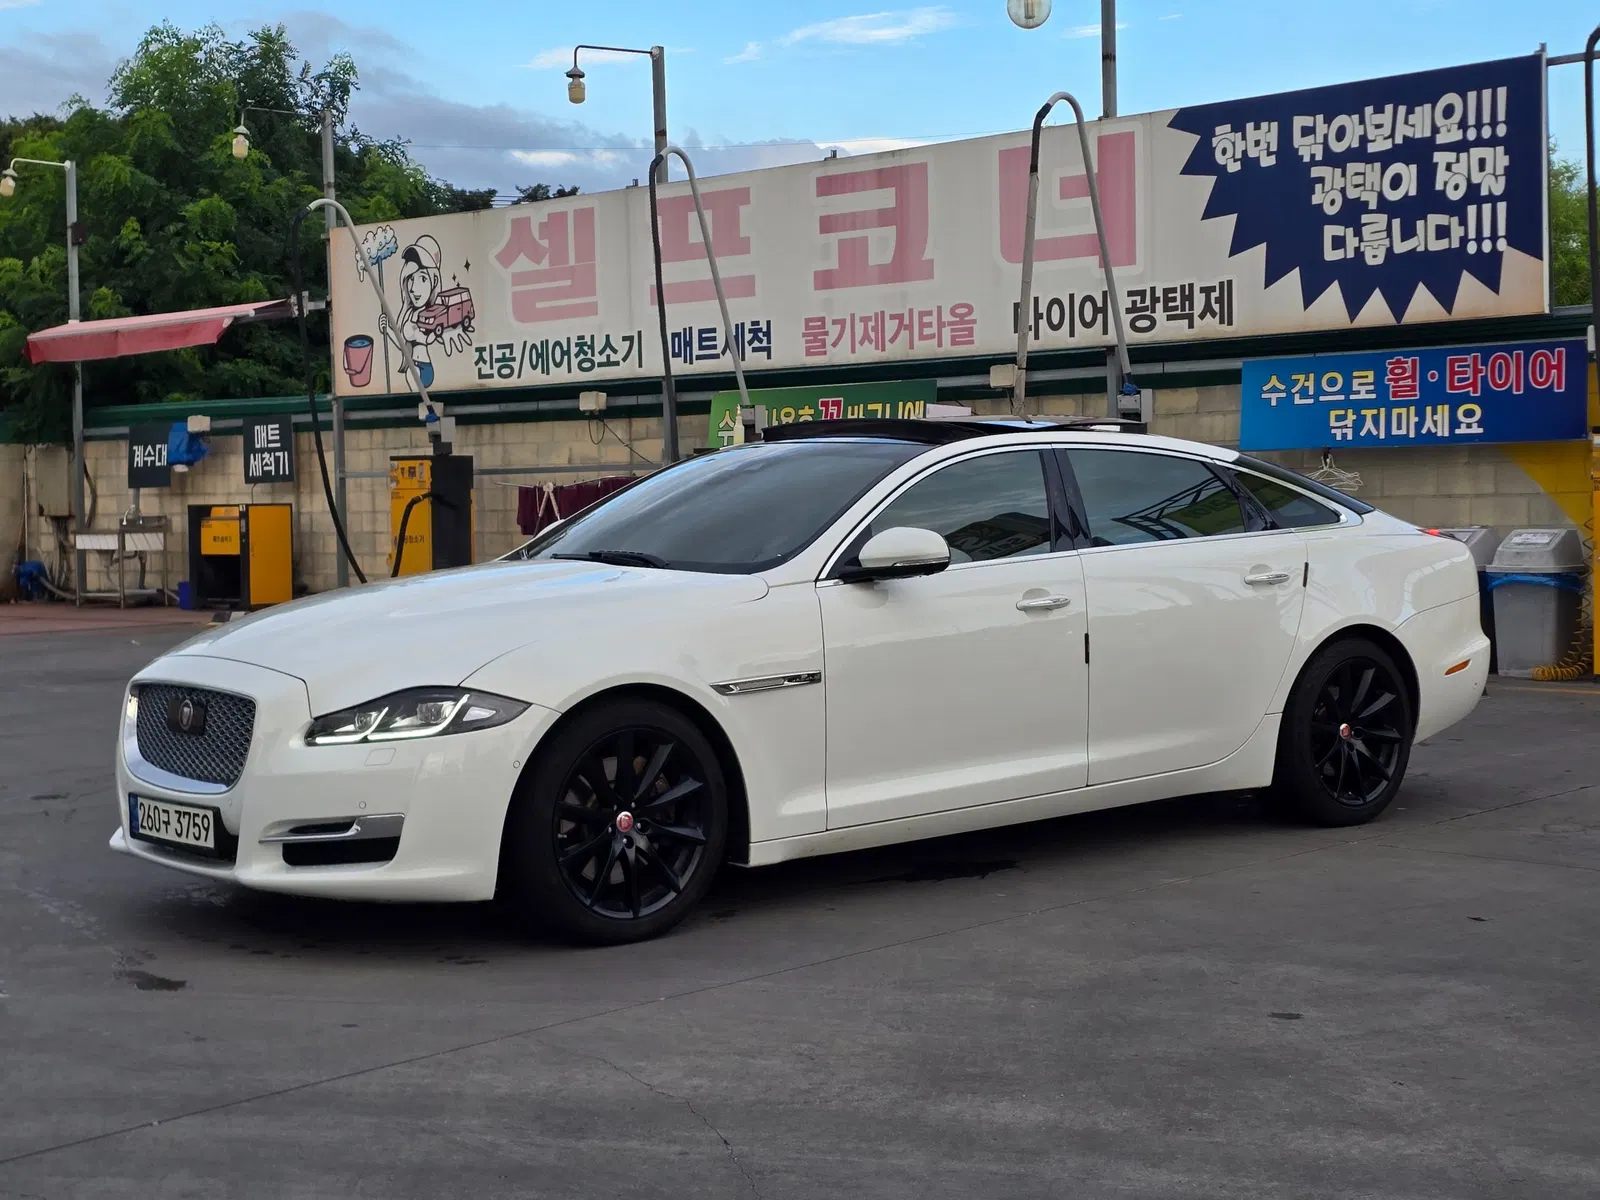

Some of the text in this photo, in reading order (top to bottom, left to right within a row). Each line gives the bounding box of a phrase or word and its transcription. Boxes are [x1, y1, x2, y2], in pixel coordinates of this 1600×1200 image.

[1212, 86, 1509, 173] 한번 닦아보세요!!!
[1310, 145, 1510, 215] 광택이 정말
[1125, 279, 1233, 333] 광택제
[671, 320, 772, 365] 매트세척
[801, 302, 978, 357] 물기제거타올
[474, 330, 643, 380] 진공/에어청소기
[1260, 370, 1377, 406] 수건으로
[254, 423, 281, 449] 매트
[1328, 403, 1485, 440] 닦지마세요
[132, 443, 168, 468] 계수대
[249, 451, 289, 477] 세척기
[139, 801, 211, 843] 260구 3759
